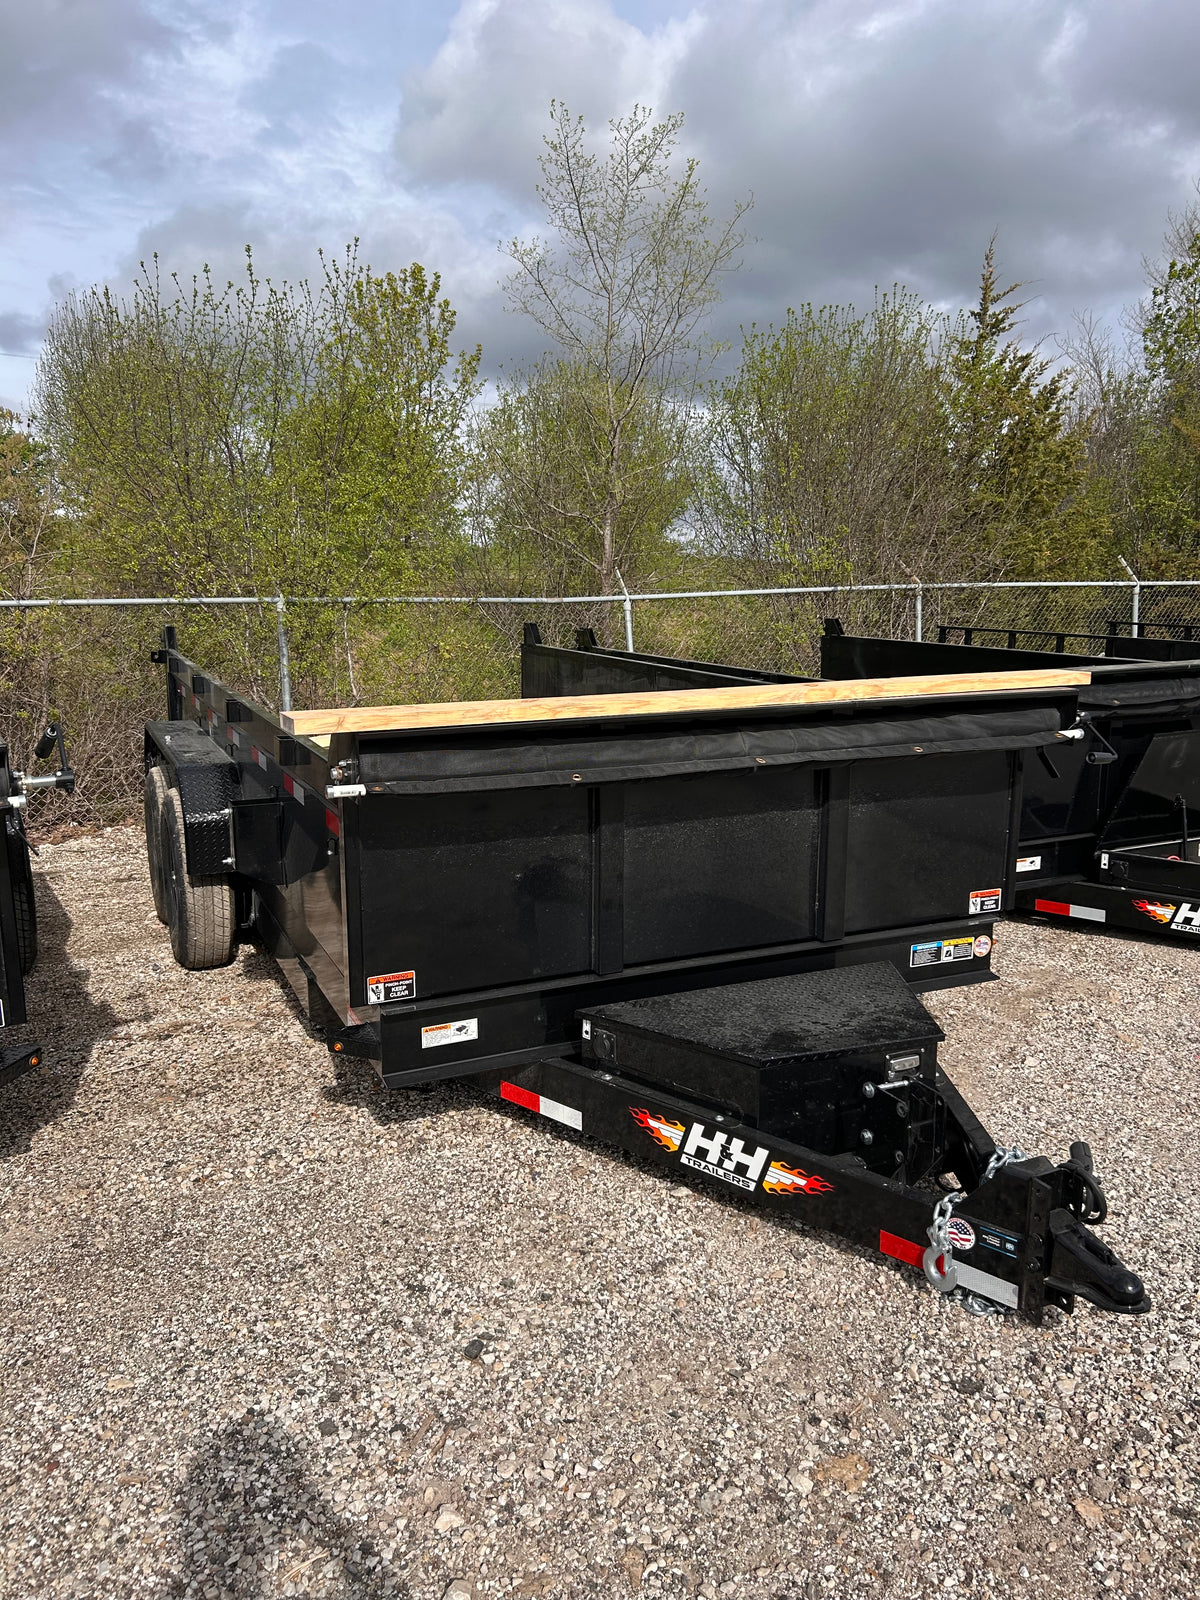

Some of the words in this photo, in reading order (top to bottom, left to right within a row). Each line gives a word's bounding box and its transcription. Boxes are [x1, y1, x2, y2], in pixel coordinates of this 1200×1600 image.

[383, 972, 409, 982] WARNING
[385, 979, 412, 989] PINCH-POINT
[392, 985, 407, 993] KEEP
[390, 990, 409, 998] CLEAR
[684, 1122, 769, 1181] H&H
[685, 1156, 751, 1189] TRAILERS
